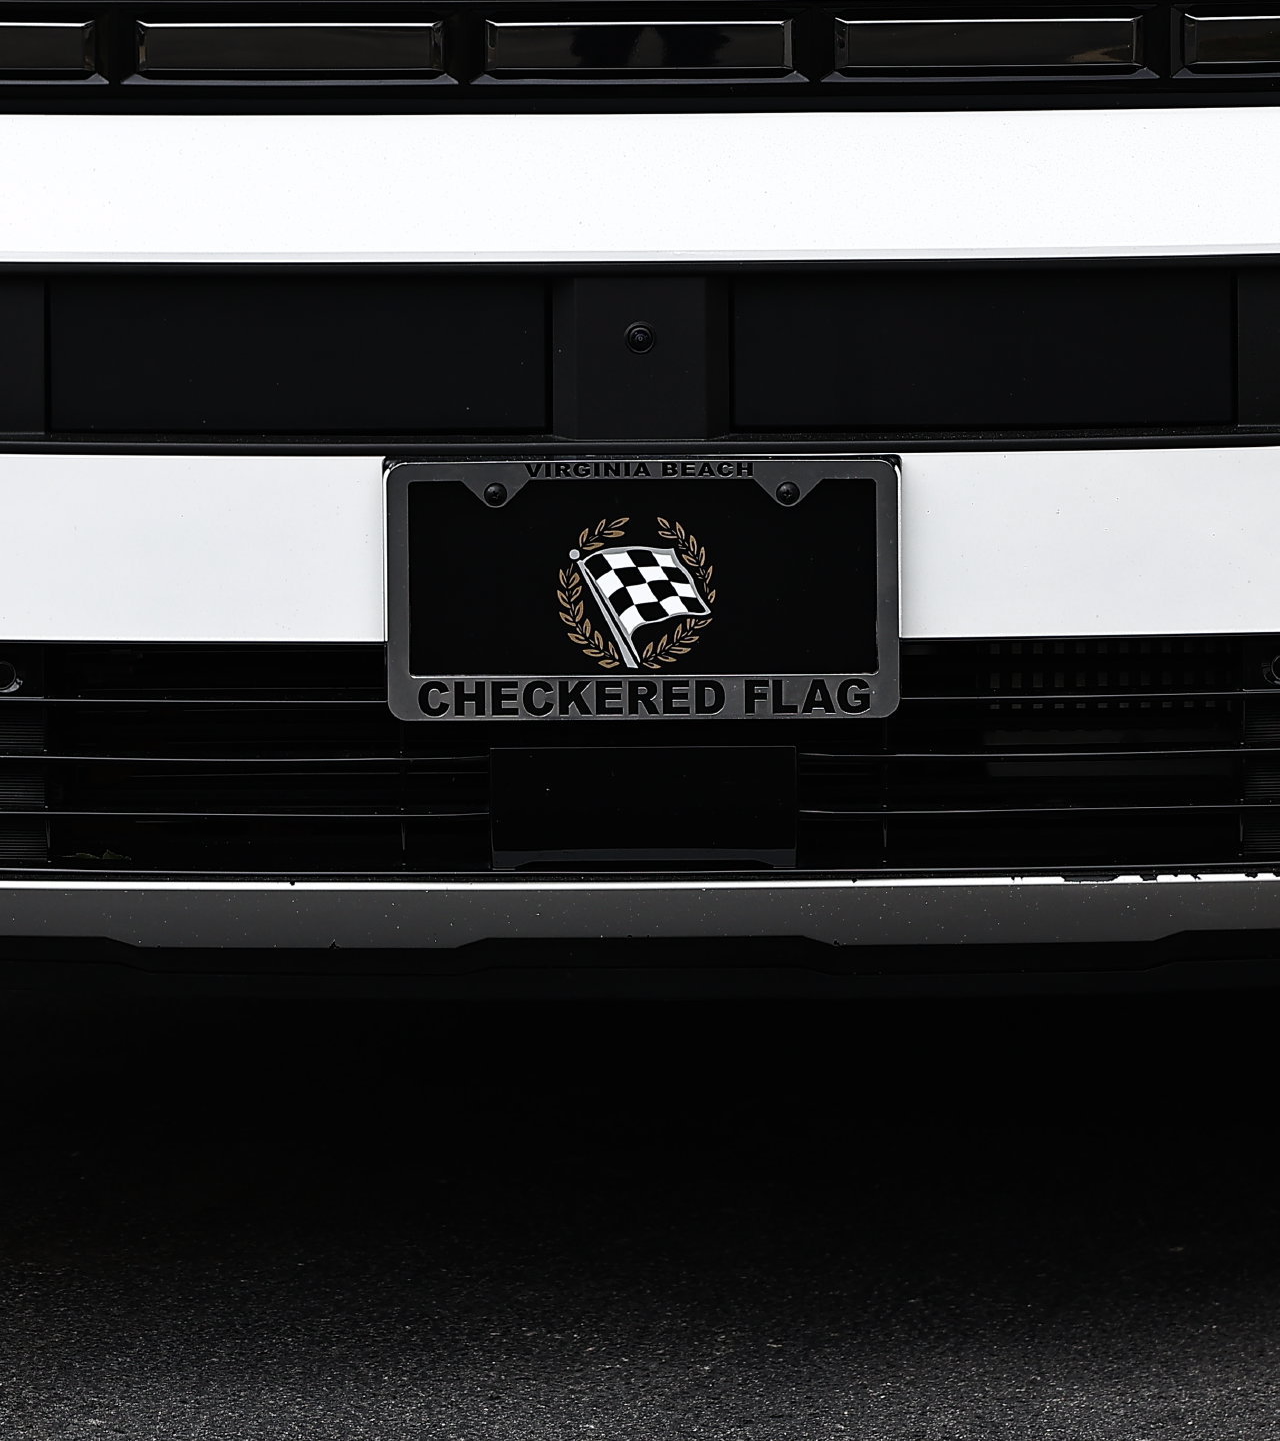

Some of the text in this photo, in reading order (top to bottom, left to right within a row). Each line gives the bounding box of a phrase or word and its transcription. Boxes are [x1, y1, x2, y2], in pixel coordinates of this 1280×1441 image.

[525, 462, 754, 478] VIRGINIA BEACH
[418, 678, 872, 717] CHECKERED FLAG
